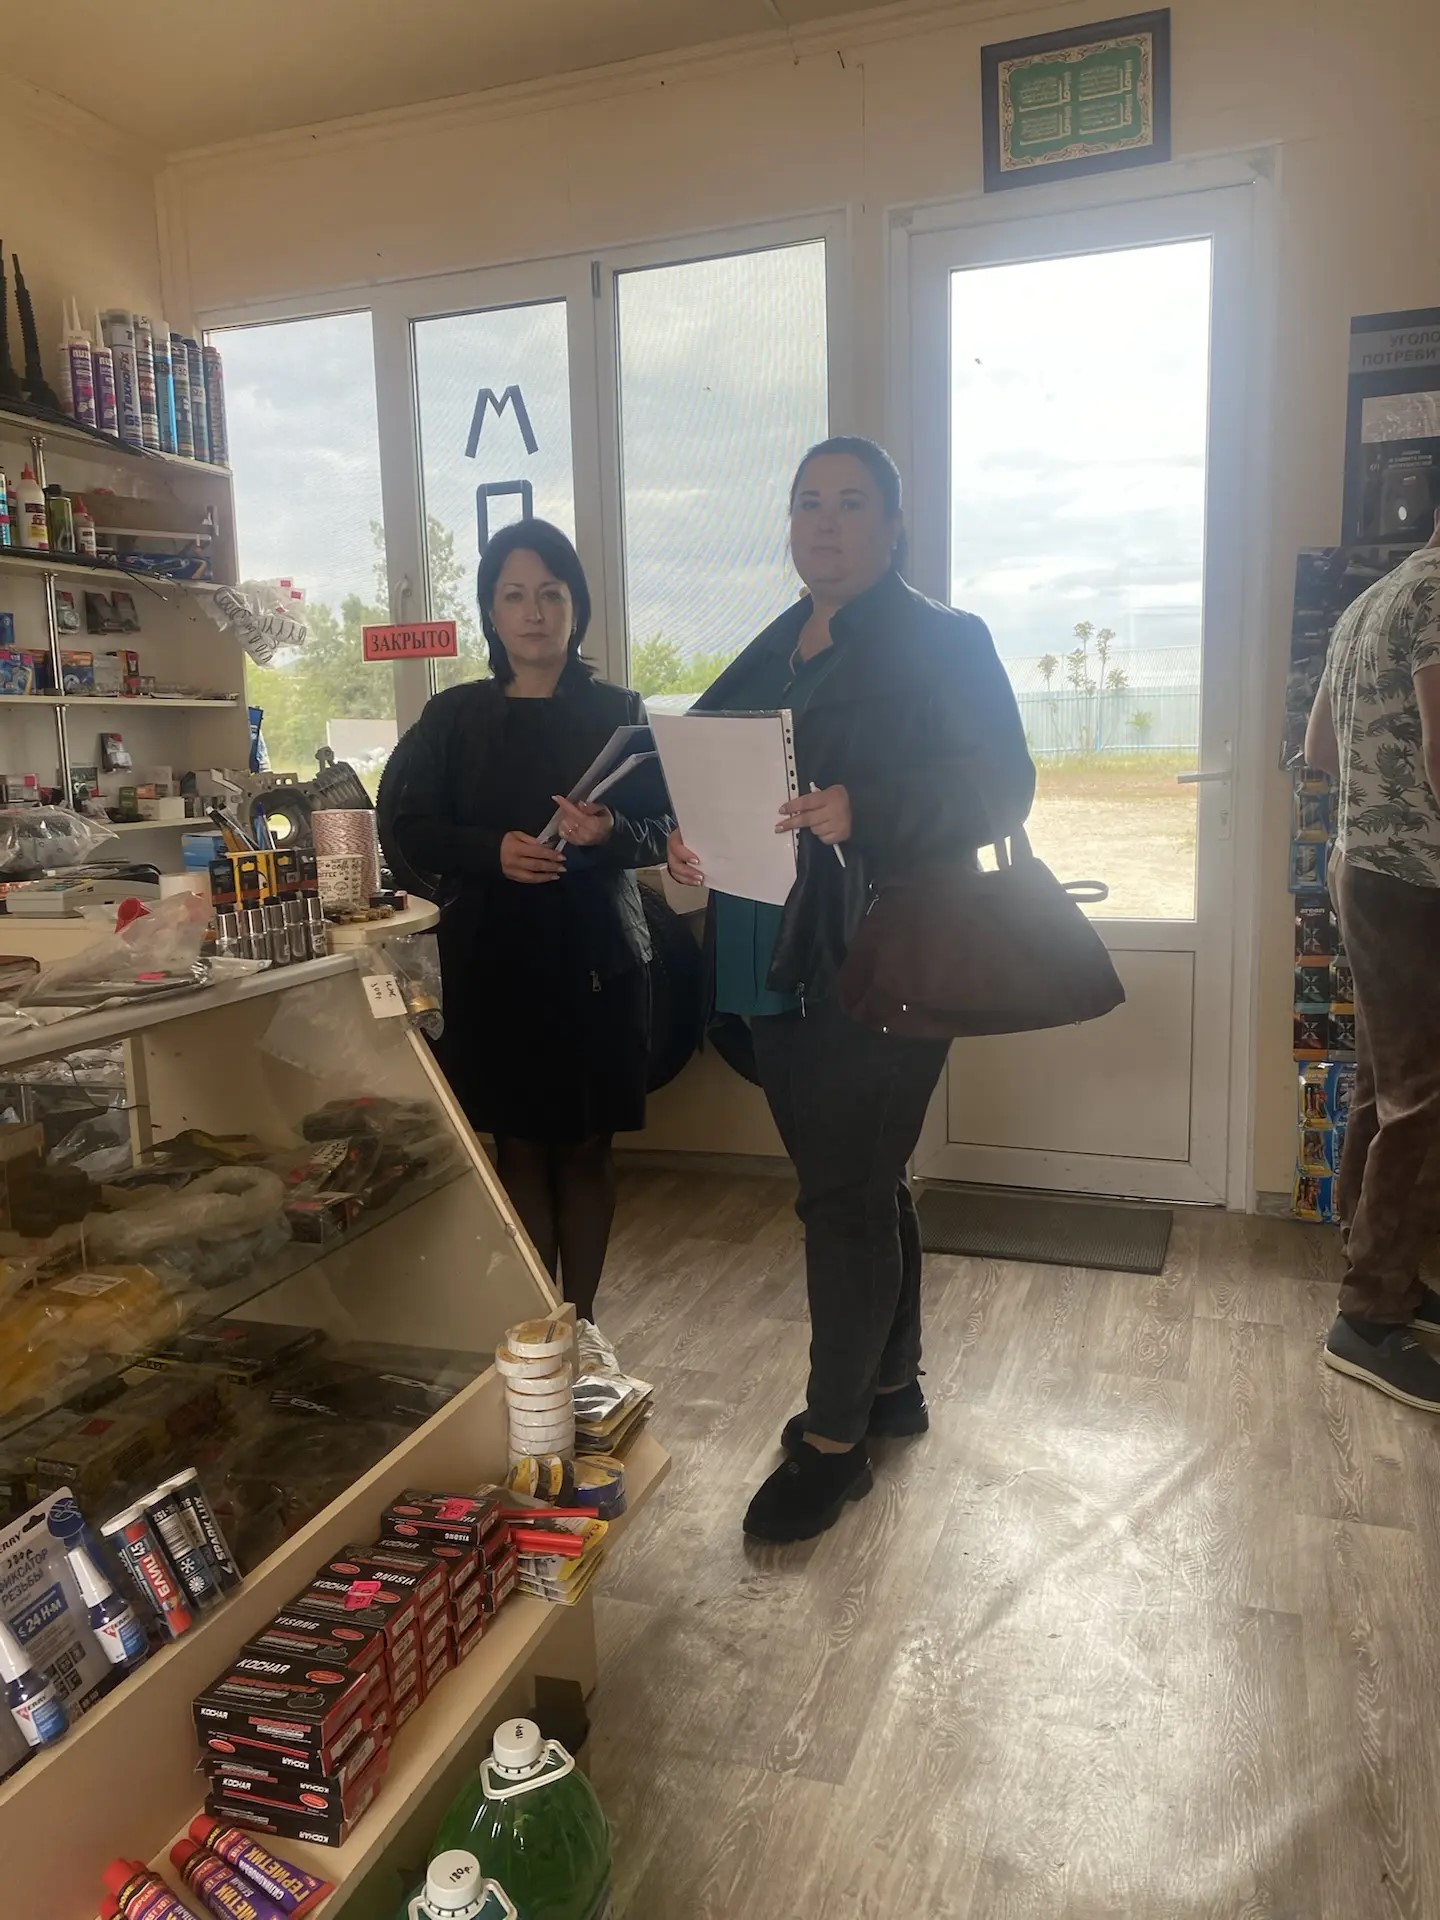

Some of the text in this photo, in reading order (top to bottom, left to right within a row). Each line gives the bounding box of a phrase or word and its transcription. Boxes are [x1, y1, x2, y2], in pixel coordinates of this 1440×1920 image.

[1362, 347, 1440, 367] ПОТРЕБИ
[371, 629, 450, 652] ЗАКРЫТО
[1, 1569, 44, 1607] РЕЗЬБЫ
[236, 1658, 291, 1675] KOCHAR
[200, 1707, 228, 1720] KOCHAR
[281, 1756, 309, 1770] KOCHAR
[222, 1778, 251, 1790] KOCHAR
[299, 1782, 329, 1794] KOCHAR
[298, 1831, 329, 1844] KOCHAR
[244, 1847, 311, 1903] ГЕРМЕТИК
